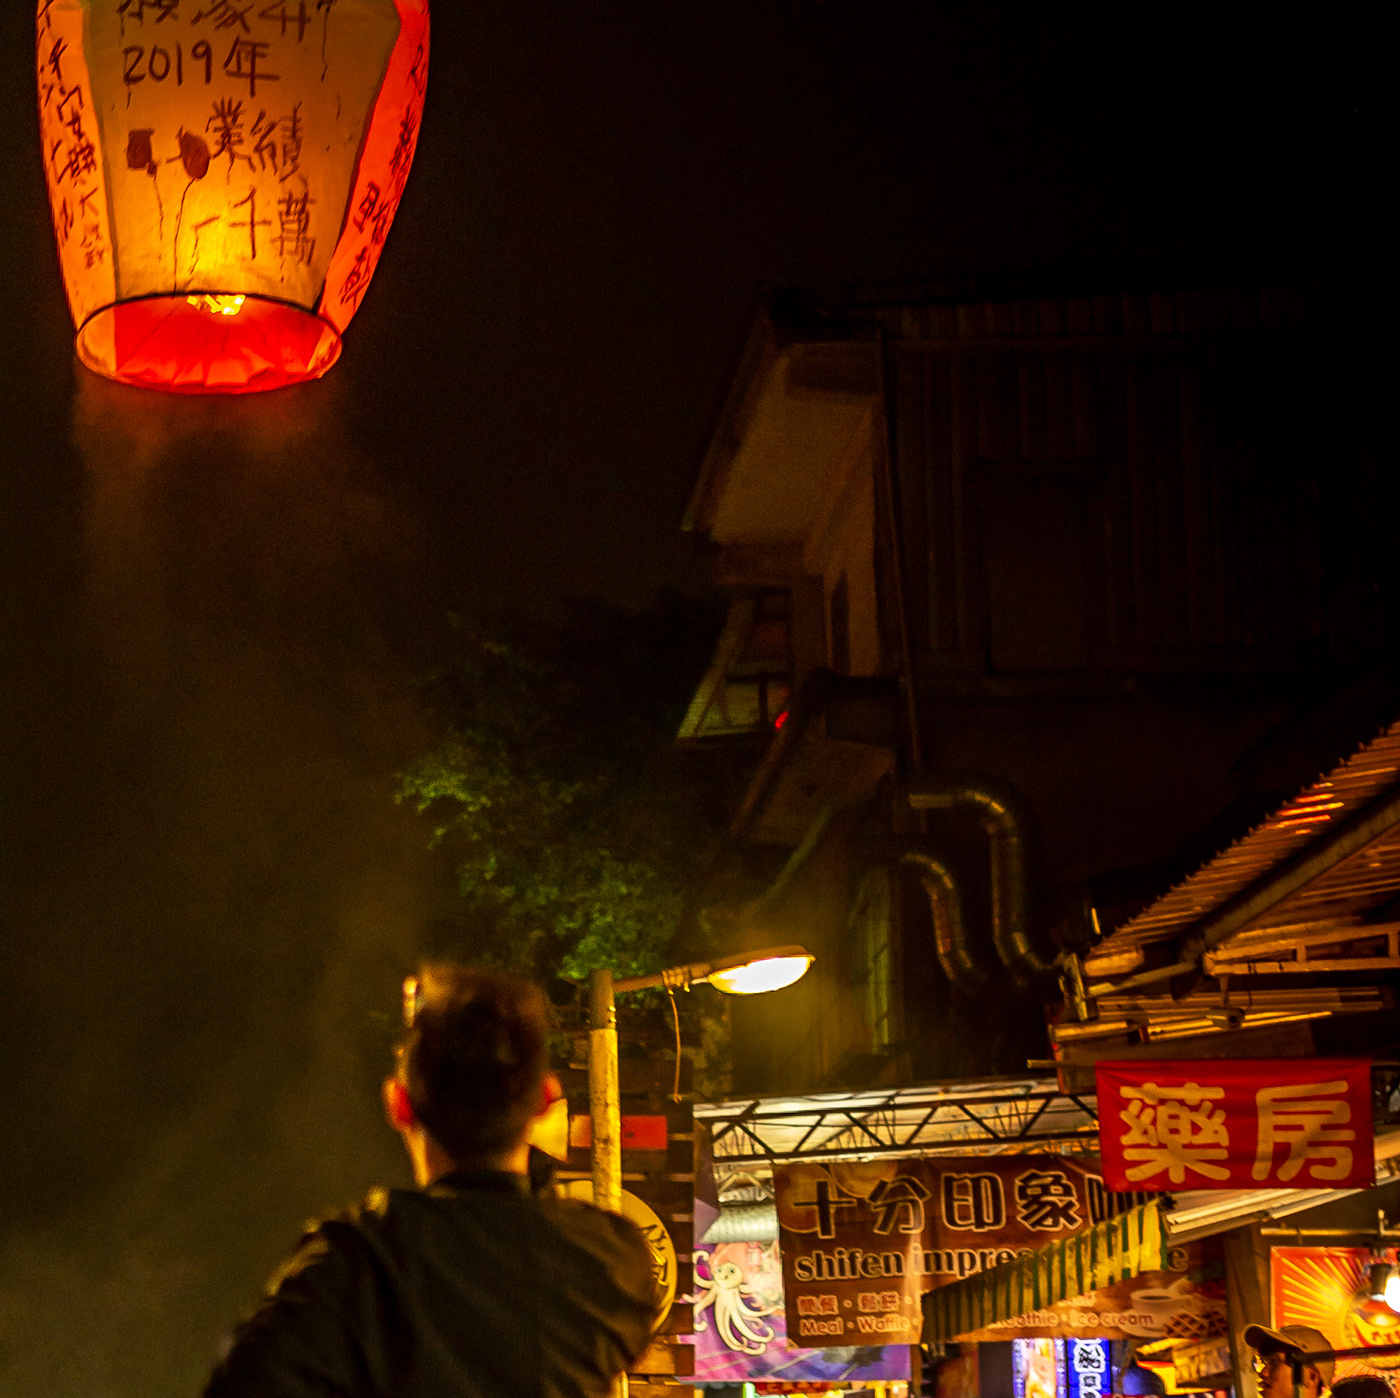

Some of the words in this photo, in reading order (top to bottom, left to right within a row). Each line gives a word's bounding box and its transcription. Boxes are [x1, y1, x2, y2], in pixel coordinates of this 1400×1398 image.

[122, 34, 282, 98] 2019年
[1118, 1080, 1358, 1183] 藥房
[793, 1166, 1103, 1239] 十分印象
[795, 1247, 906, 1282] shifen
[910, 1243, 1032, 1280] impre
[800, 1316, 844, 1336] Meal
